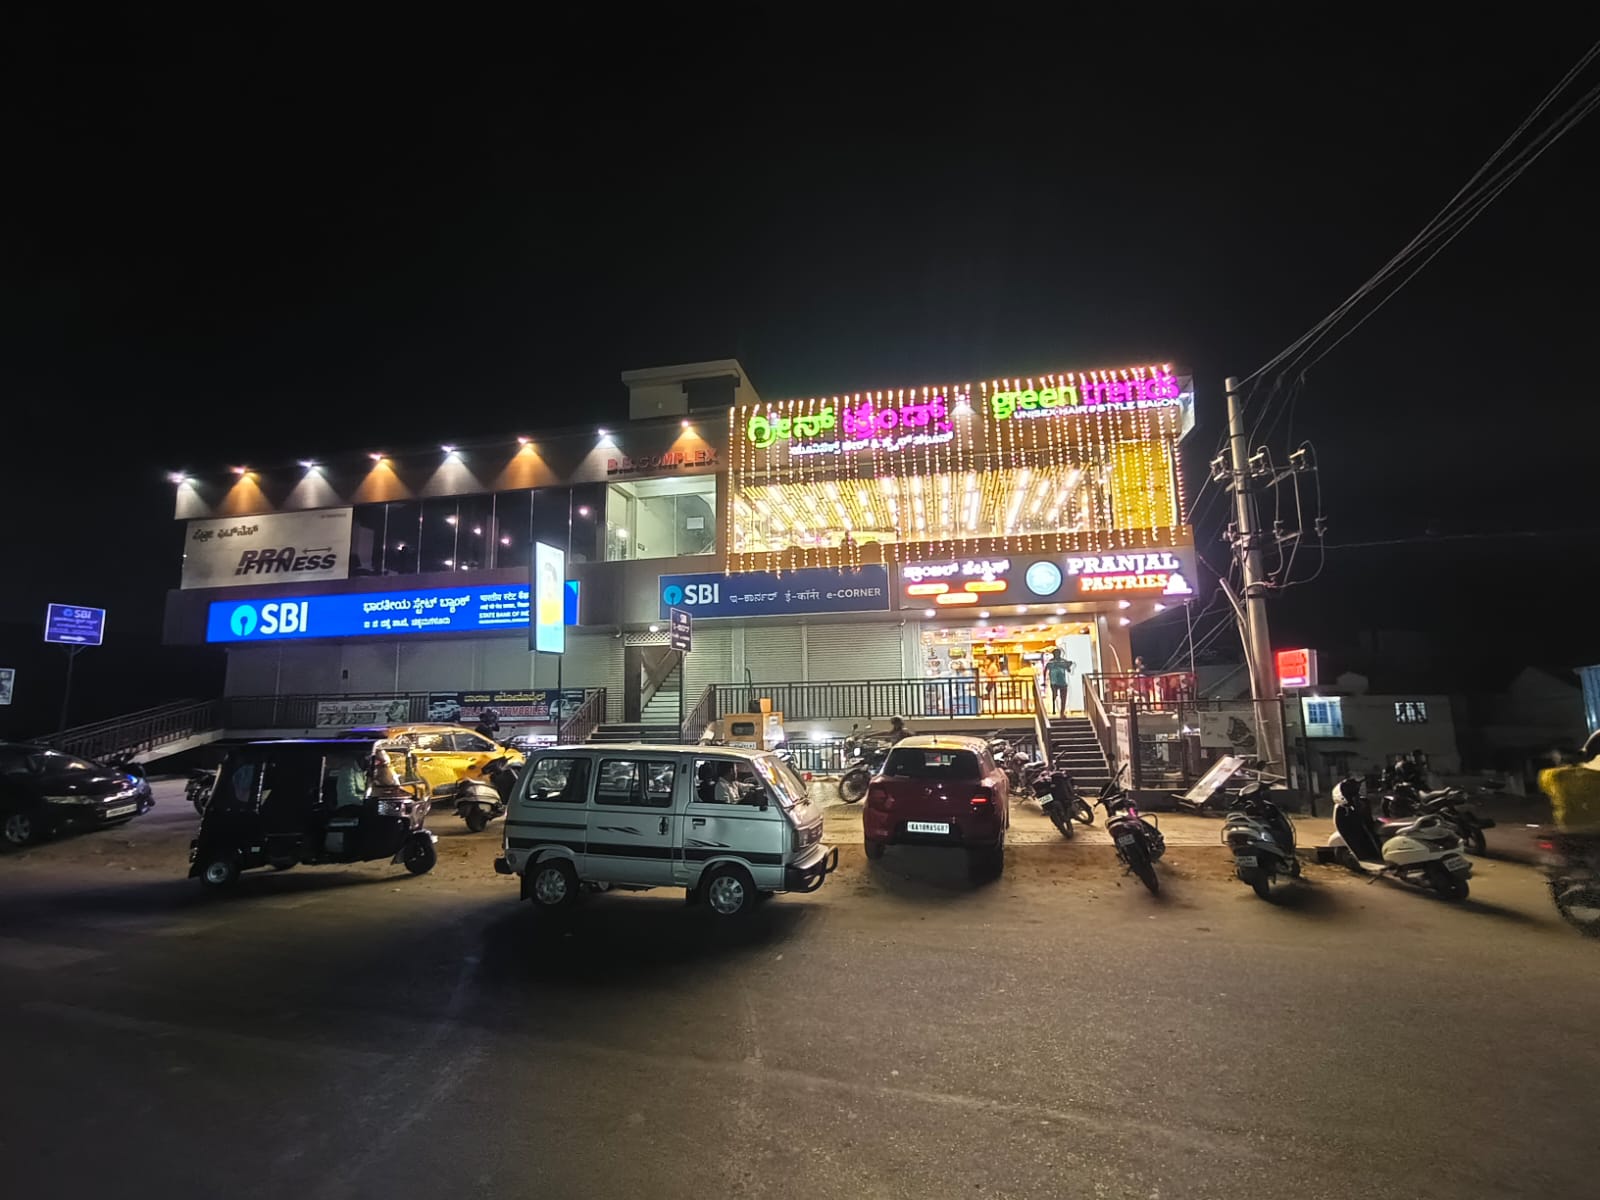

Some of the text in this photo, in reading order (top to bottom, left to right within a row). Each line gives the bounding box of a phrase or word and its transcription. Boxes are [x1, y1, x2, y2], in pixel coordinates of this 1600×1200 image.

[991, 371, 1180, 419] green trends
[242, 553, 337, 575] FITNESS
[1067, 553, 1179, 574] PRANJAL
[1080, 574, 1168, 591] PASTRIES
[684, 583, 719, 605] SBI
[826, 588, 881, 599] e-CORNER
[74, 610, 91, 619] SBI
[260, 602, 309, 634] SBI
